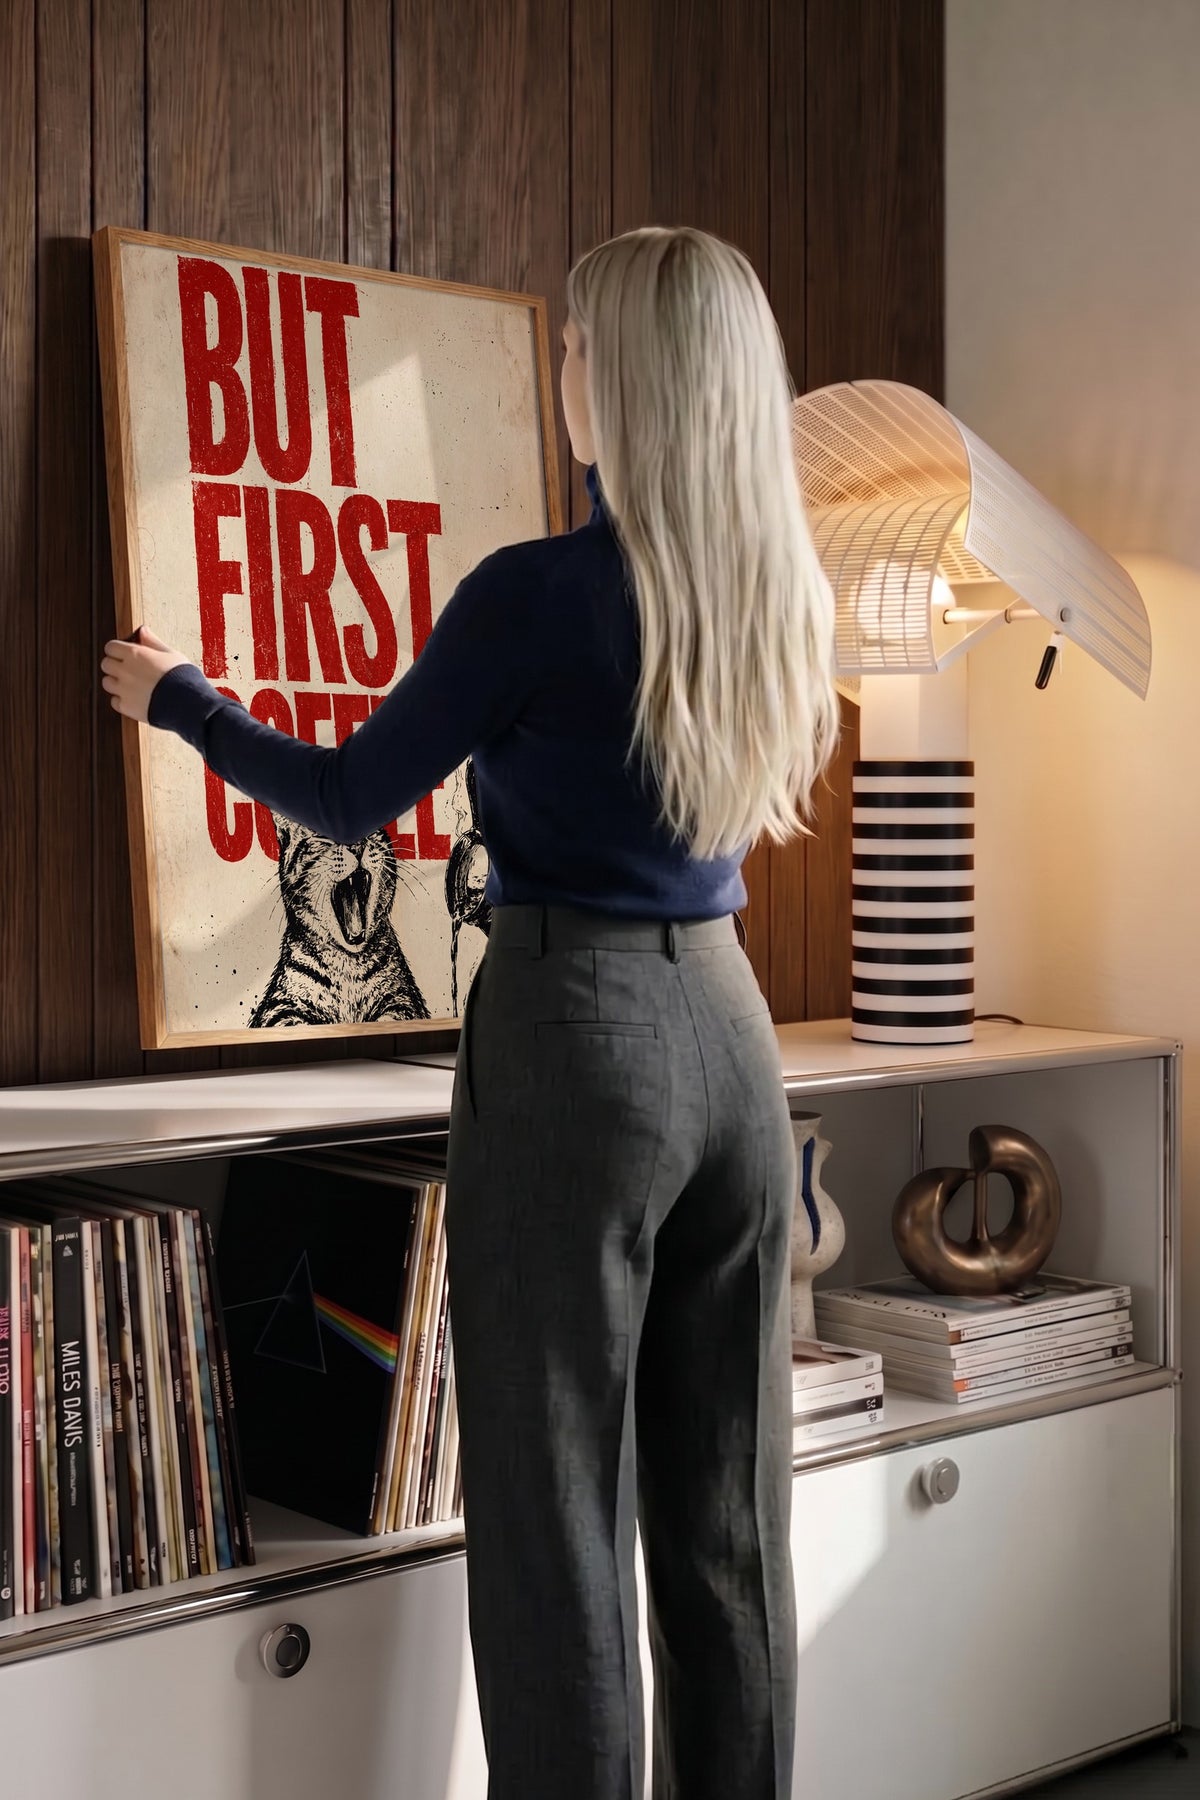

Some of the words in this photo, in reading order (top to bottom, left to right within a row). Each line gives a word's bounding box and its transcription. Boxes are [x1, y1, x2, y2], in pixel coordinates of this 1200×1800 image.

[178, 255, 360, 488] BUT
[191, 480, 442, 689] FIRST
[61, 1340, 81, 1392] MILES
[63, 1396, 83, 1448] DAVIS
